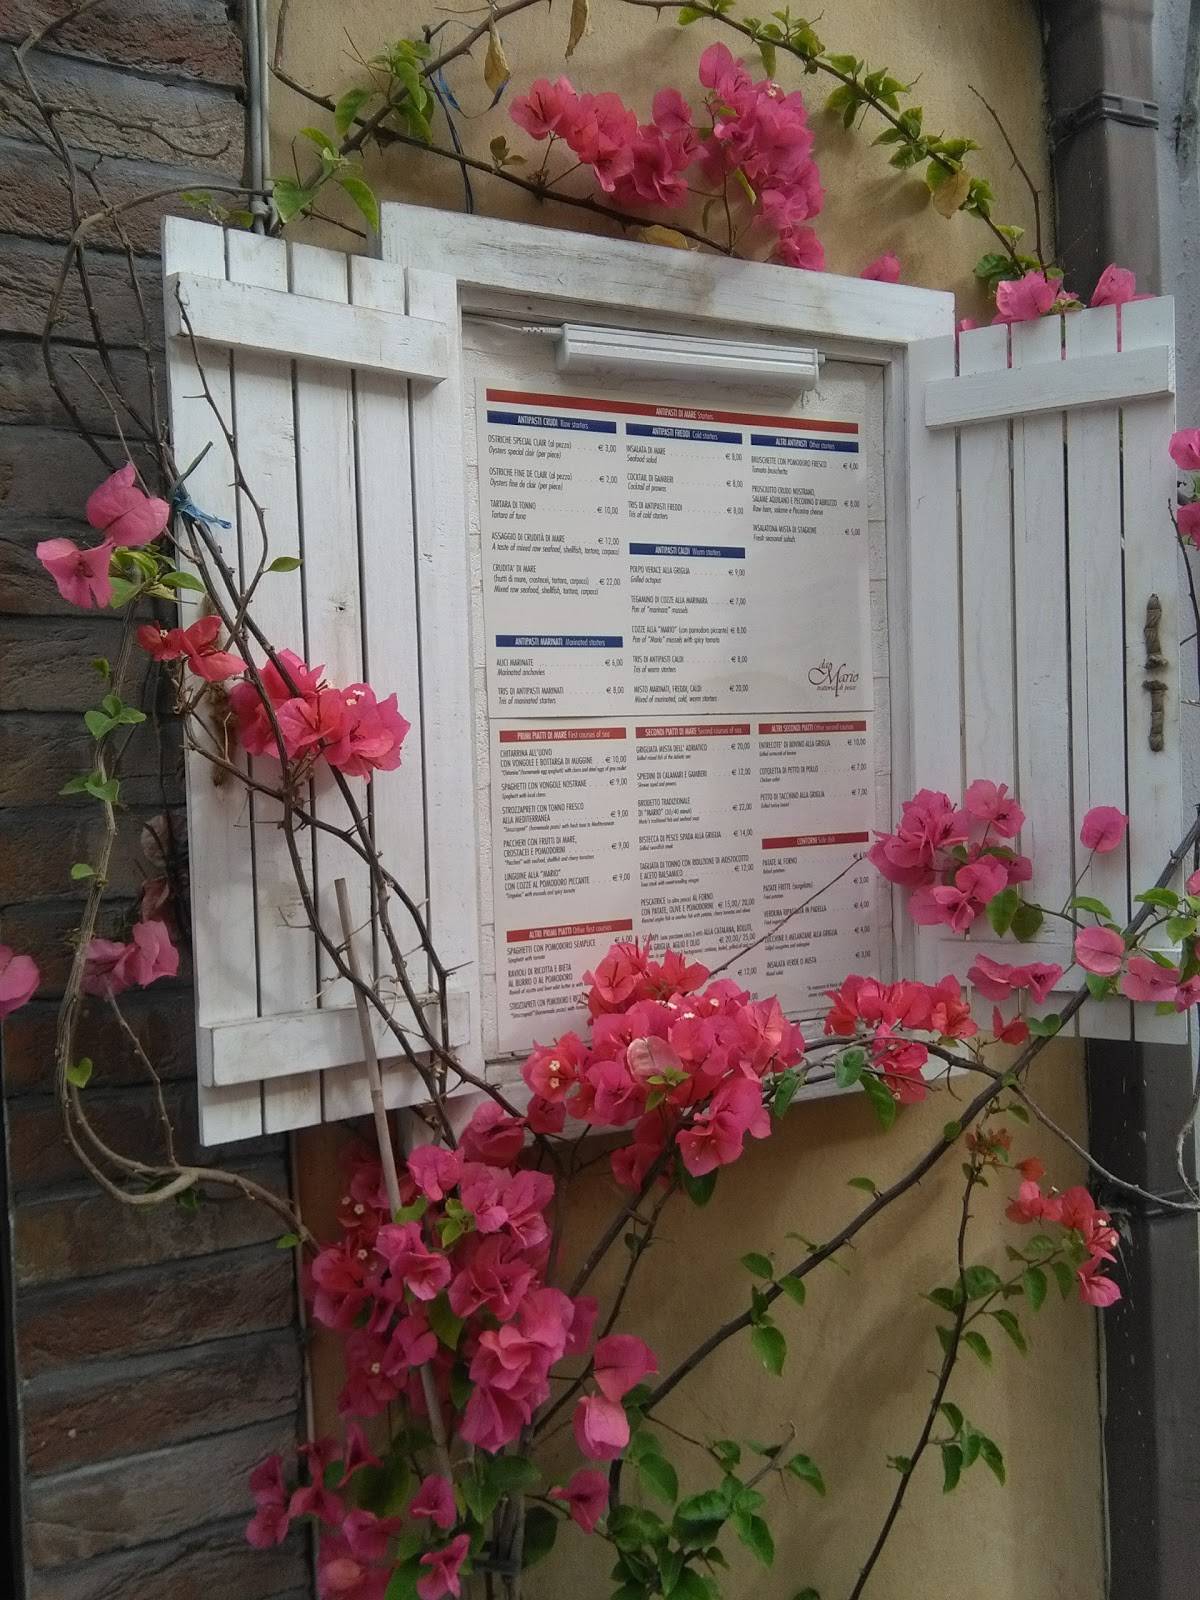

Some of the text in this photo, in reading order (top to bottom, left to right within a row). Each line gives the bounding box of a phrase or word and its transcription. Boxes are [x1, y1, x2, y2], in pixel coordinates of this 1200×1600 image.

[656, 407, 678, 417] ANTIPASTI
[684, 410, 697, 418] MARE
[697, 411, 714, 420] Starters
[517, 415, 589, 430] ANTIPASTI CRUDI Raw starters
[652, 427, 718, 439] ANTIPASTI FREDDI Cold starters
[488, 435, 511, 444] OSTRICHE
[513, 437, 532, 446] SPECIAL
[533, 439, 547, 447] CLAIR
[556, 440, 572, 450] pezzo)
[489, 446, 562, 460] Oysters special clair (per piece)
[626, 445, 647, 453] INSALATA
[654, 447, 666, 455] MARE
[489, 467, 513, 477] OSTRICHE
[514, 469, 524, 477] FINE
[534, 471, 547, 479] CLAIR
[556, 472, 572, 482] pezzo)
[627, 473, 647, 482] COCKTAIL
[654, 474, 673, 483] GAMBERI
[490, 500, 511, 509] TARTARA
[519, 501, 536, 510] TONNO
[644, 502, 666, 510] ANTIPASTI
[667, 503, 682, 511] FREDDI
[492, 532, 516, 541] ASSAGGIO
[524, 534, 544, 542] CRUDITÀ
[552, 535, 565, 543] MARE
[605, 538, 619, 546] 12,00
[655, 546, 677, 554] ANTIPASTI
[678, 547, 690, 555] CALDI
[706, 548, 721, 556] starters
[523, 565, 536, 573] MARE
[630, 565, 690, 574] POLPO VERACE ALLA GRIGLIA
[515, 638, 605, 646] ANTIPASTI MARINATI Marinated starters
[808, 664, 859, 697] Mario
[498, 687, 508, 695] TRIS
[516, 687, 540, 695] ANTIPASTI
[541, 687, 564, 695] MARINATI
[501, 779, 586, 791] SPAGHETTI CON VONGOLE NOSTRANE
[502, 803, 584, 814] STROZZAPRETI CON TONNO FRESCO
[503, 838, 526, 847] PACCHERI
[527, 838, 537, 846] CON
[539, 837, 554, 845] FRUTTI
[562, 835, 577, 845] MARE,
[639, 835, 659, 843] BISTECCA
[705, 831, 721, 839] GRIGLIA
[507, 940, 596, 955] SPAGHETTI CON POMODORO SEMPLICE
